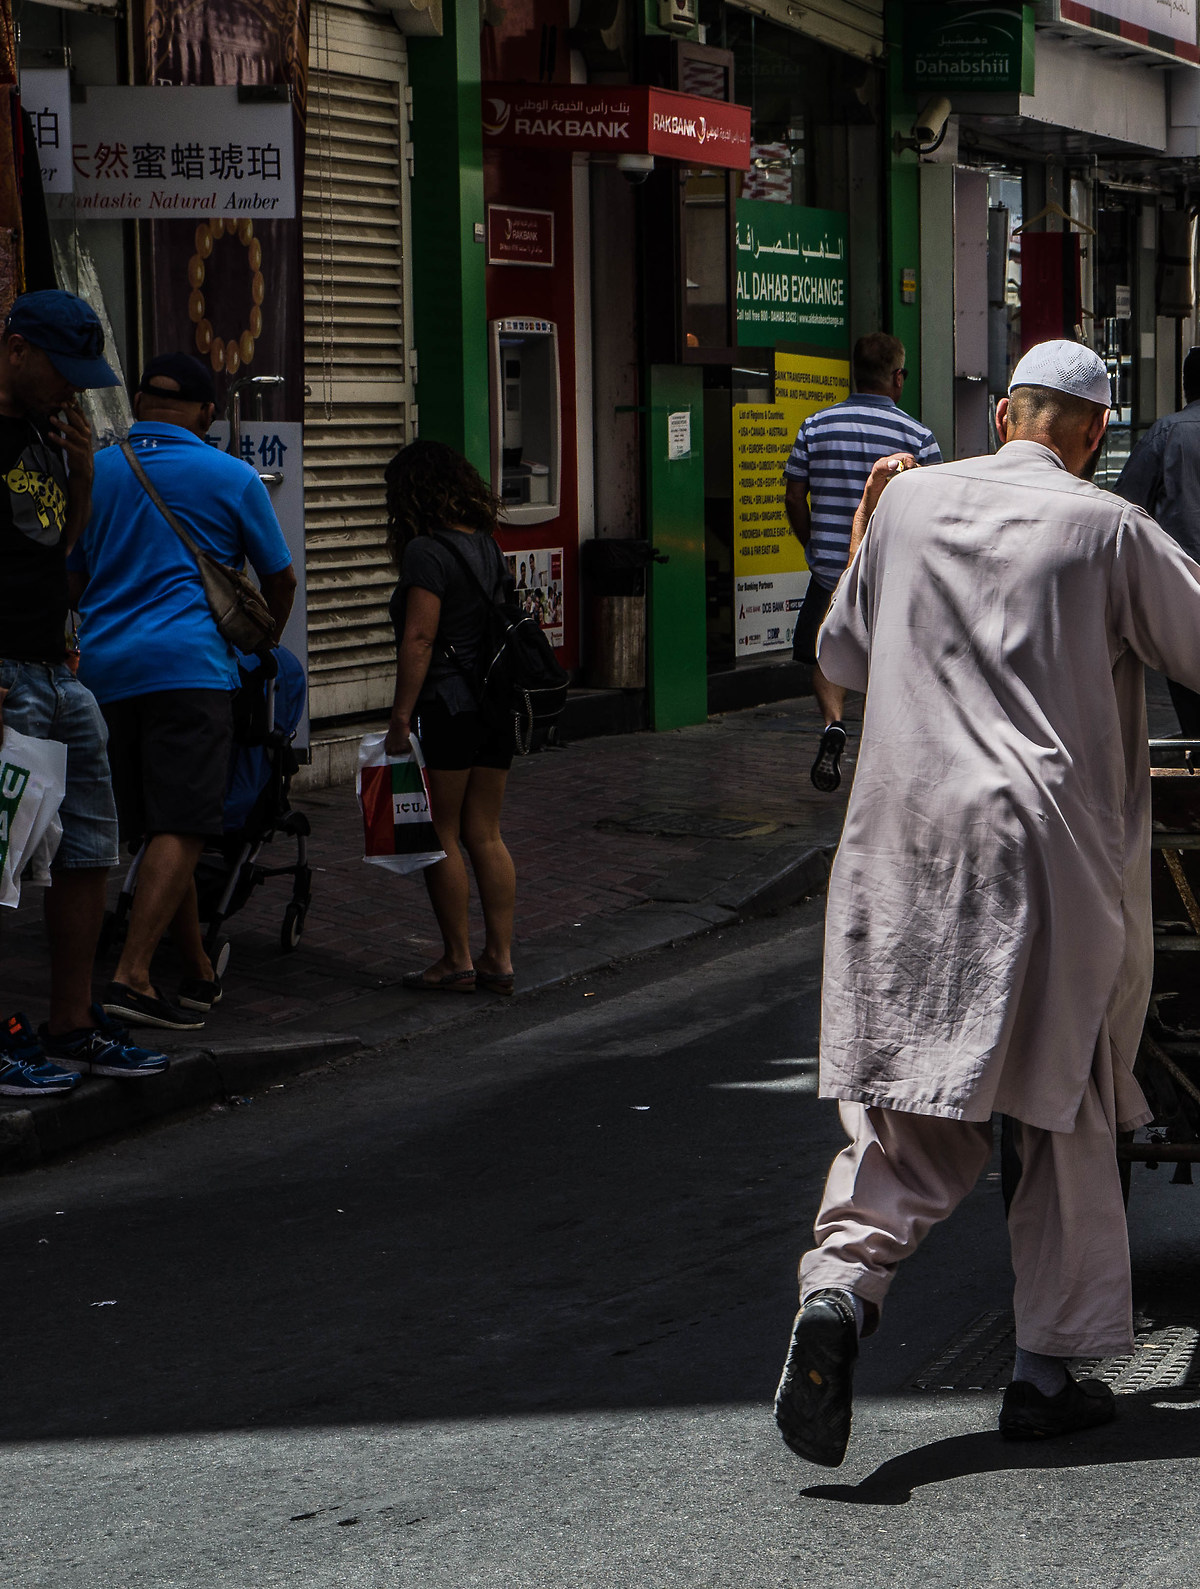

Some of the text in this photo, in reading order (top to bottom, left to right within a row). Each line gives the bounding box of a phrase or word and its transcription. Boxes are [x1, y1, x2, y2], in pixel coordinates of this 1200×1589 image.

[915, 59, 1009, 73] Dahabshiil
[514, 98, 548, 115] الوطني
[551, 98, 584, 114] الخيمة
[611, 101, 630, 116] بنك
[514, 118, 631, 139] RAKBANK
[652, 112, 697, 138] RAKBANK
[149, 191, 216, 210] Natural
[224, 191, 279, 211] Amber
[736, 271, 845, 306] AL DAHAB EXCHANGE
[752, 310, 760, 321] free
[787, 371, 811, 384] TRANSFERS
[775, 387, 788, 398] CHINA
[749, 410, 764, 422] Regions
[744, 583, 759, 592] Banking
[758, 581, 774, 590] Partners
[772, 601, 784, 613] BANK
